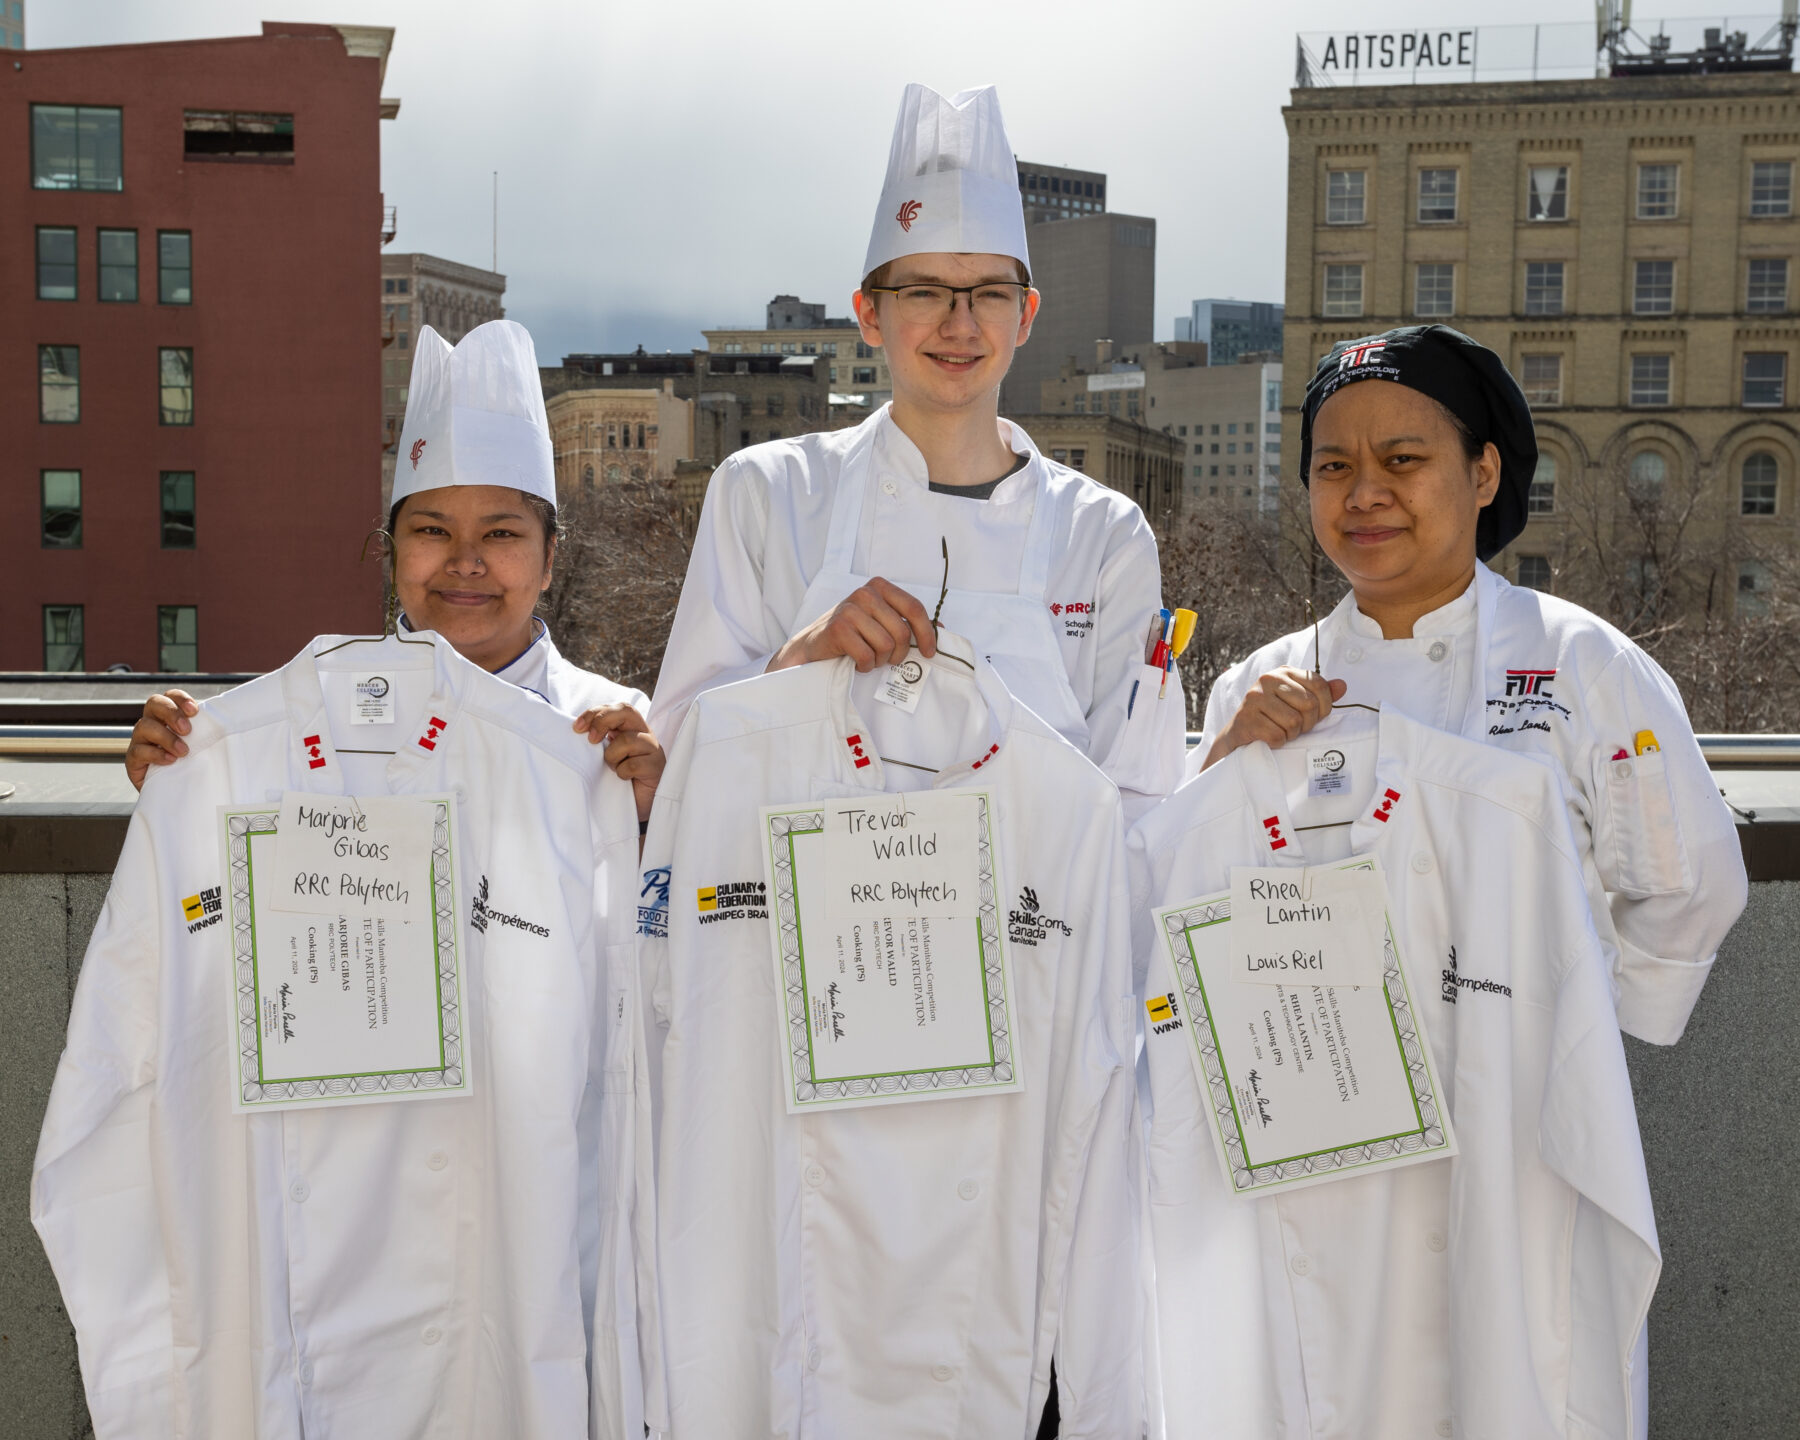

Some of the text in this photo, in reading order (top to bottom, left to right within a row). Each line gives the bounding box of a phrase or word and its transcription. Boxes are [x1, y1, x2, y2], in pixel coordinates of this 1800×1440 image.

[1322, 31, 1472, 70] ARTSPACE
[298, 805, 368, 838] Marjorie
[837, 810, 916, 834] Trevor
[334, 836, 390, 861] Gibas
[873, 832, 936, 860] Walld
[294, 872, 409, 905] RRC Polytech
[717, 882, 757, 896] CULINARY
[717, 895, 766, 909] FEDERATION
[851, 881, 957, 908] RRC Polytech
[1250, 878, 1302, 900] Rhea
[484, 905, 550, 938] Compétences
[638, 910, 662, 922] FOOD
[699, 910, 745, 925] WINNIPEG
[1008, 910, 1037, 926] Skills
[1267, 903, 1331, 924] Lantin
[364, 932, 373, 947] OF
[908, 929, 918, 944] OF
[1008, 922, 1047, 939] Canada
[307, 926, 318, 984] Cooking (PS)
[339, 914, 351, 991] ARJORIE GIBAS
[378, 938, 387, 973] Manitoba
[853, 925, 866, 982] Cooking (PS)
[874, 936, 882, 970] POLYTECH
[886, 950, 897, 987] WALLD
[923, 935, 932, 972] Manitoba
[1247, 950, 1323, 971] Louis Riel
[365, 949, 377, 1030] PARTICIPATION
[379, 975, 388, 1025] Competition
[909, 945, 926, 1027] PARTICIPATION
[926, 973, 937, 1022] Competition
[1289, 993, 1315, 1061] RHEA LANTIN
[1318, 1006, 1329, 1020] OF
[1263, 1010, 1284, 1066] Cooking (PS)
[1282, 1005, 1297, 1047] TECHNOLOGY
[1293, 1047, 1304, 1074] CENTRE
[1327, 987, 1360, 1096] Skills Manitoba Competition
[1321, 1021, 1350, 1103] PARTICIPATION
